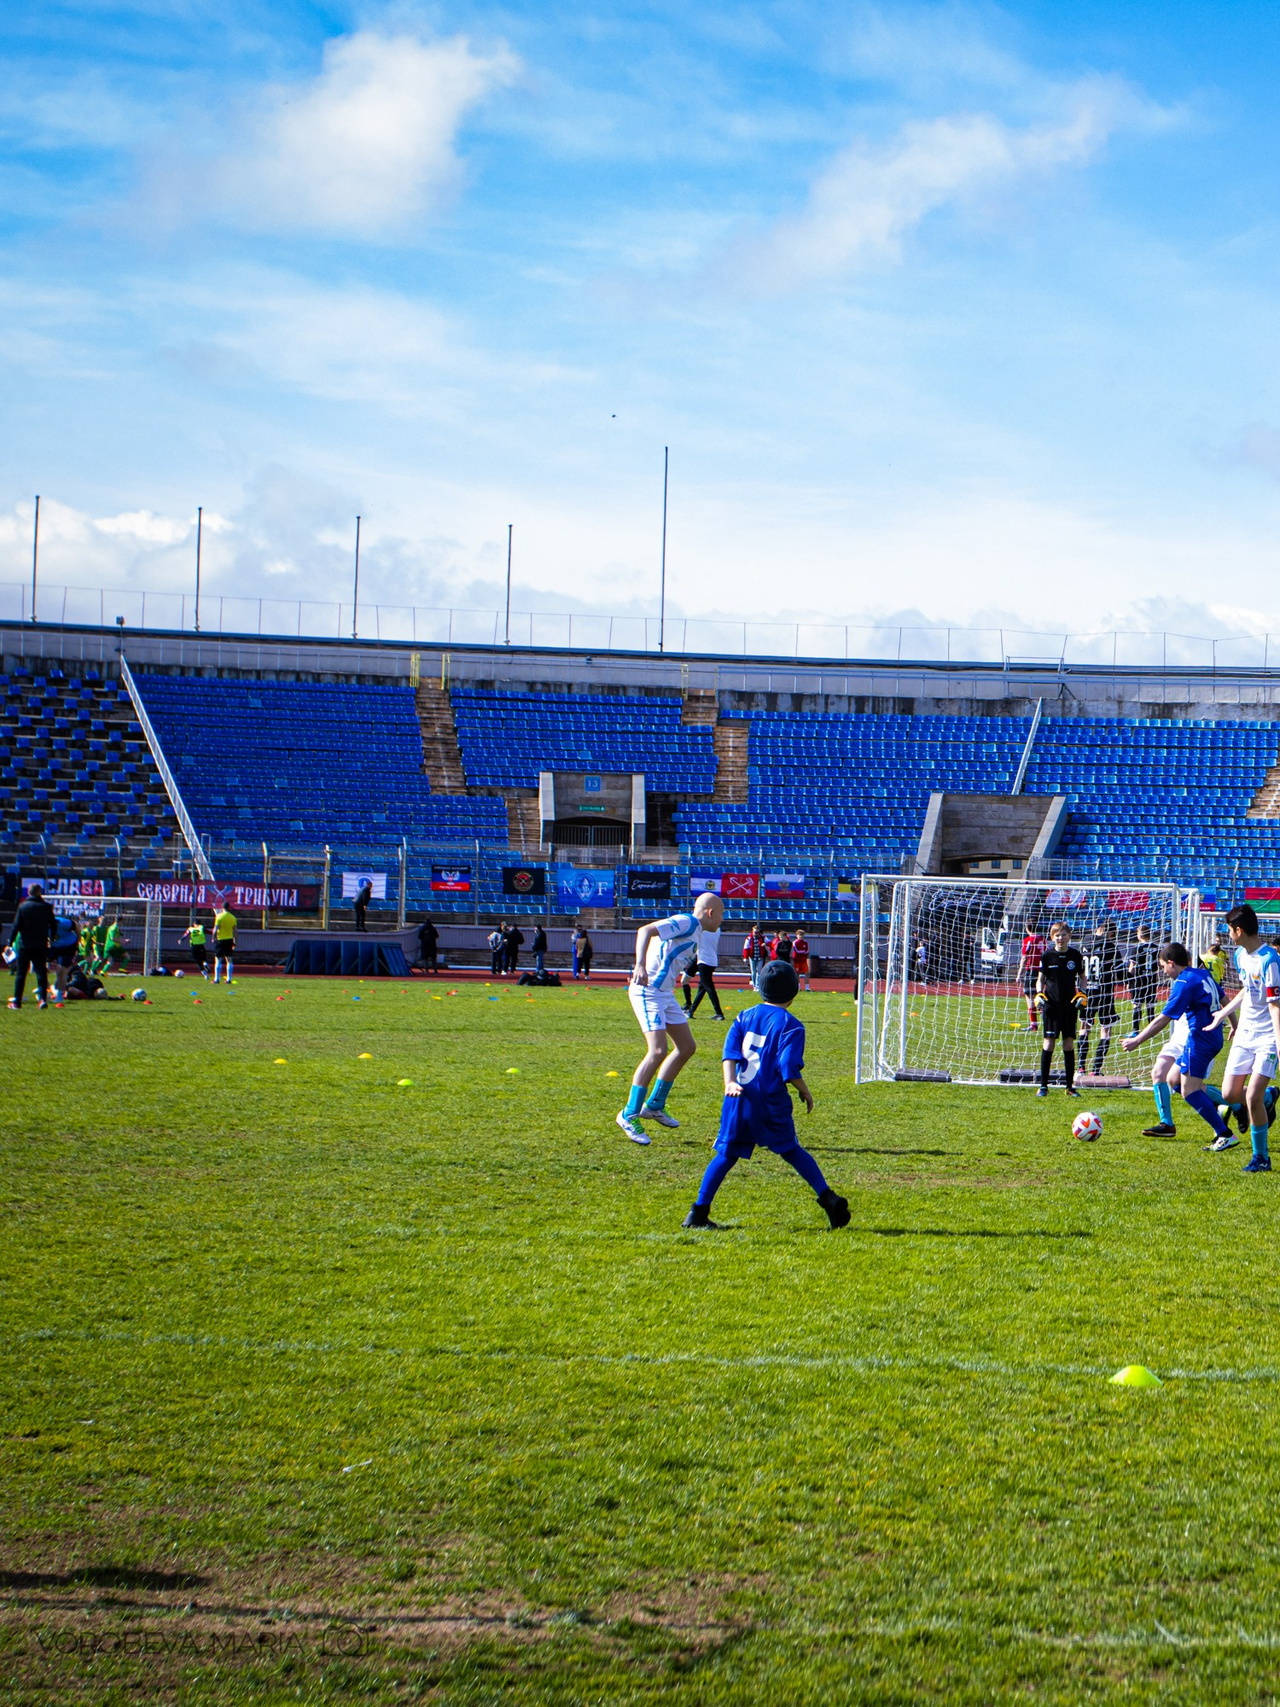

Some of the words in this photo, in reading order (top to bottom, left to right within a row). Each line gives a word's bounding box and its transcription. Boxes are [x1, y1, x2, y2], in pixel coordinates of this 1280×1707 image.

[45, 878, 104, 896] СЛАВА
[234, 886, 298, 907] ТРИБУНА
[562, 880, 573, 895] N
[597, 881, 608, 896] F
[736, 1031, 767, 1085] 5
